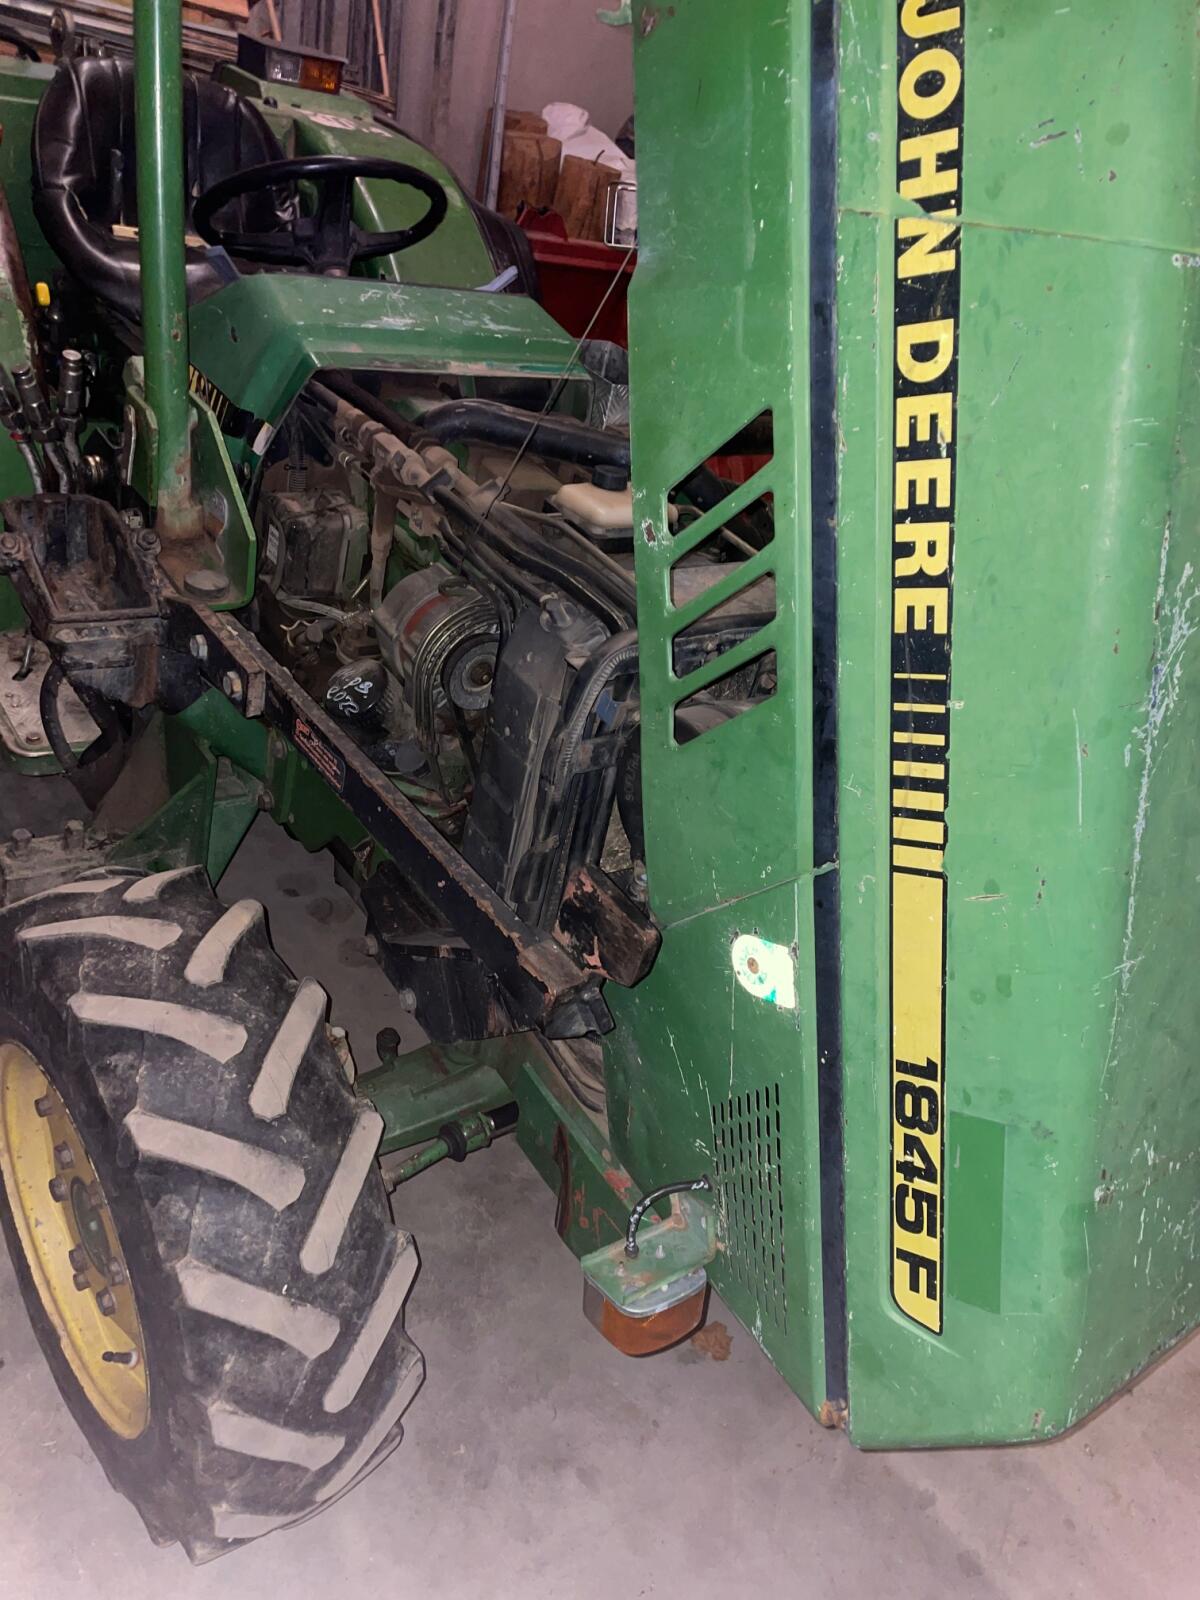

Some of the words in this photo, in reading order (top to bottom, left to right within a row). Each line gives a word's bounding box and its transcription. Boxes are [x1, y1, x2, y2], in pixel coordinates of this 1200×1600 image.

[898, 0, 962, 279] JOHN
[894, 318, 955, 635] DEERE
[895, 1056, 940, 1240] 1845
[895, 1246, 939, 1302] F
